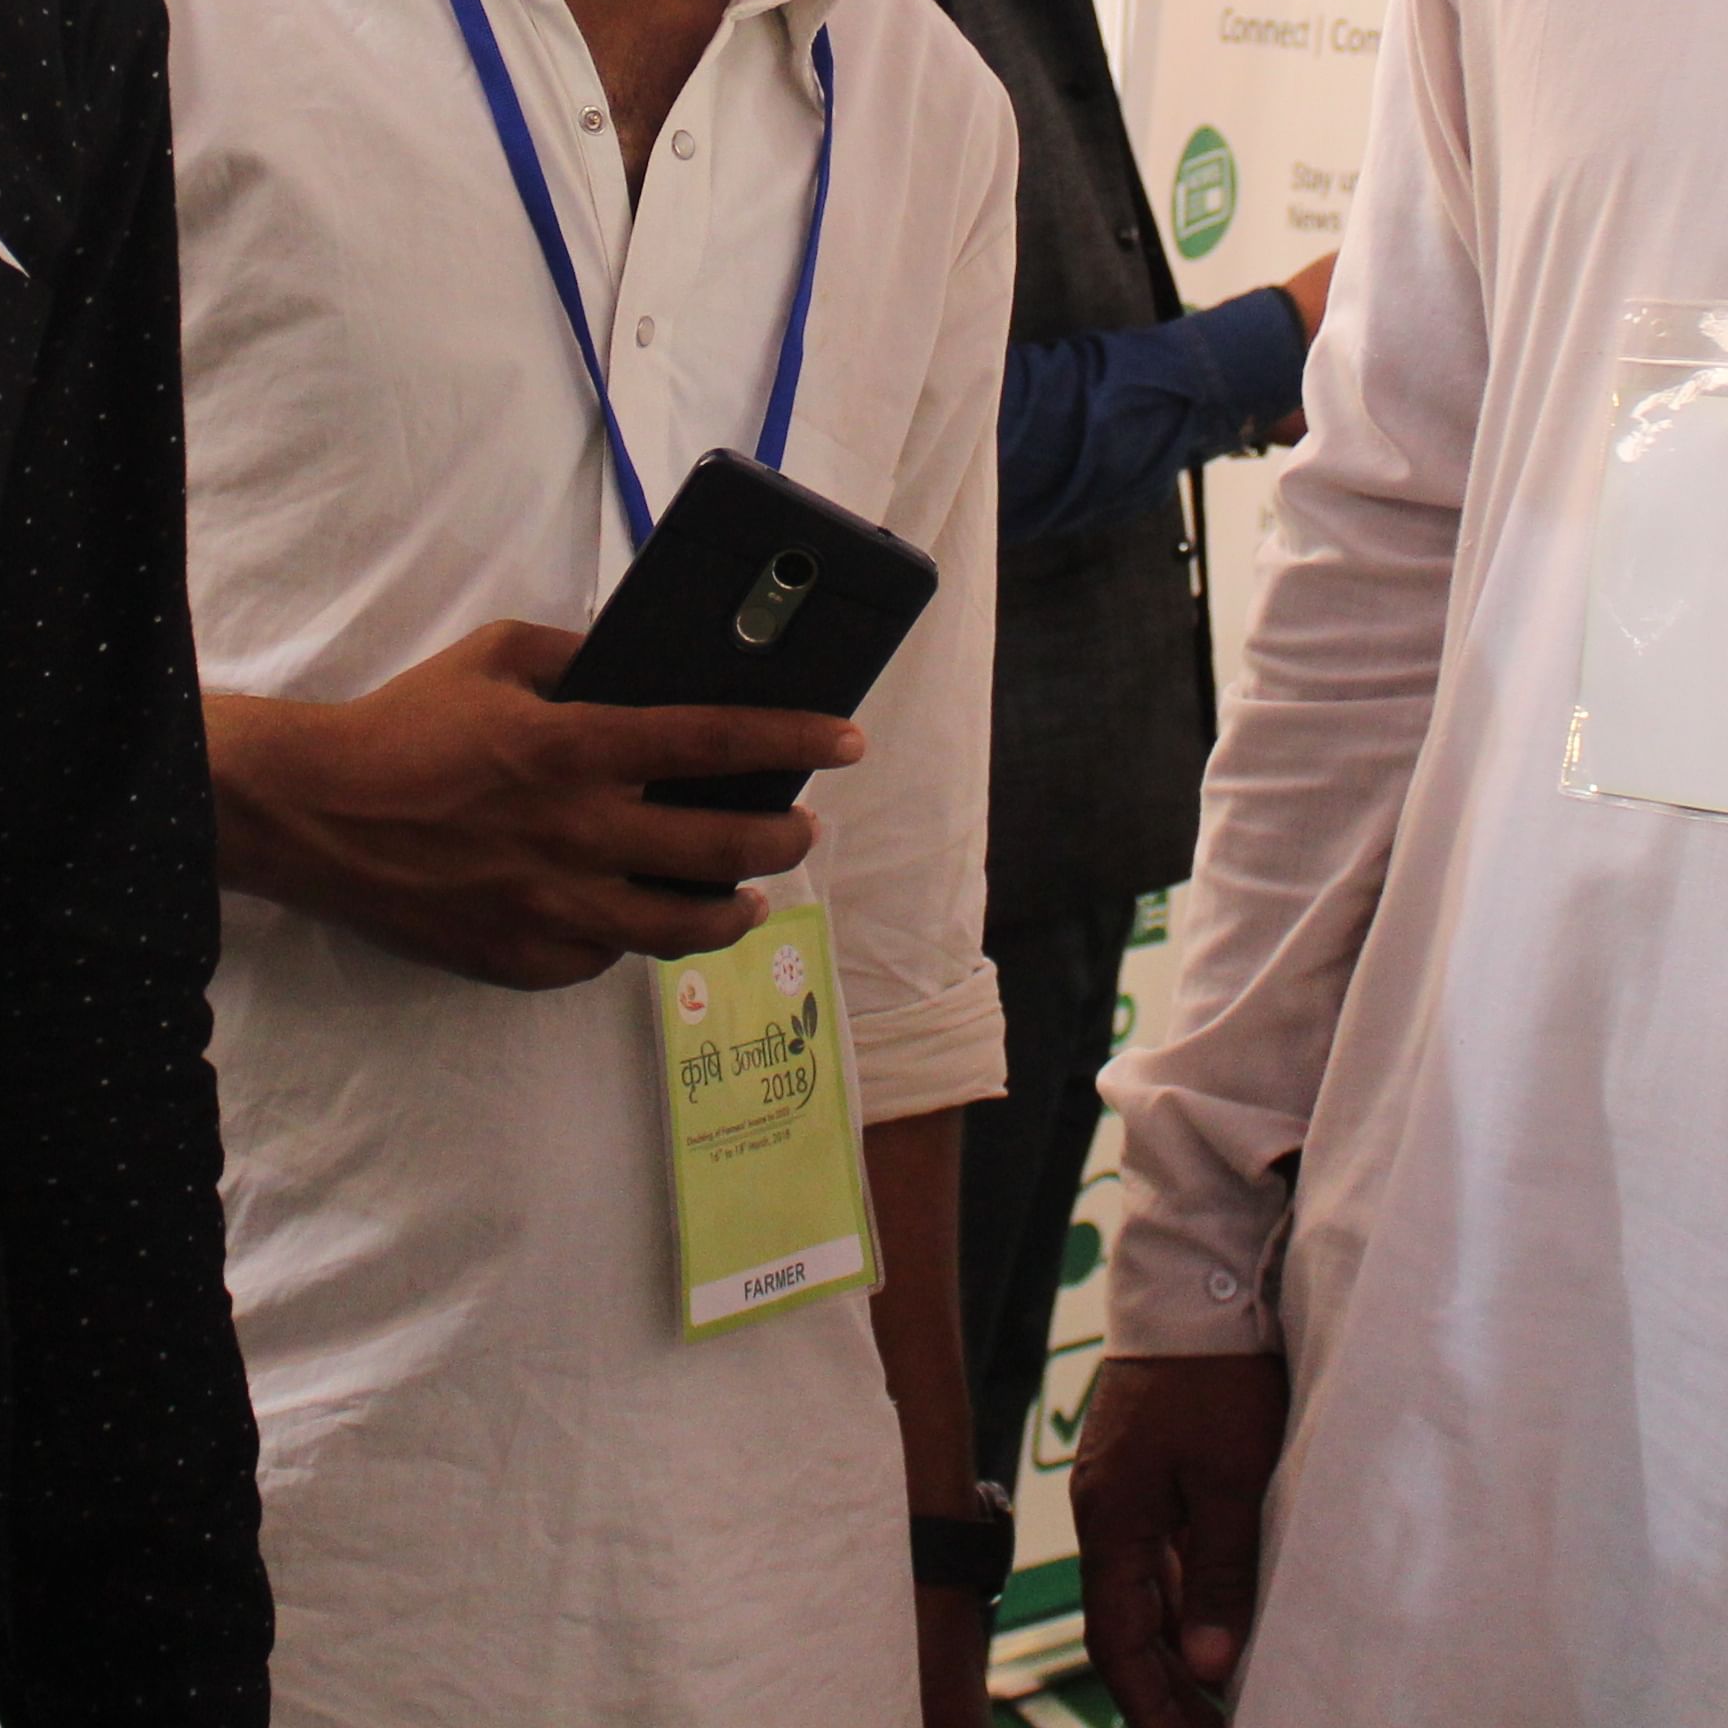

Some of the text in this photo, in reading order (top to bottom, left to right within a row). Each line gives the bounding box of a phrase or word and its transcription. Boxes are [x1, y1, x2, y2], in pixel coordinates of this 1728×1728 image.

[1219, 6, 1311, 50] Connect
[761, 1066, 809, 1105] 2018
[743, 1261, 807, 1302] FARMER
